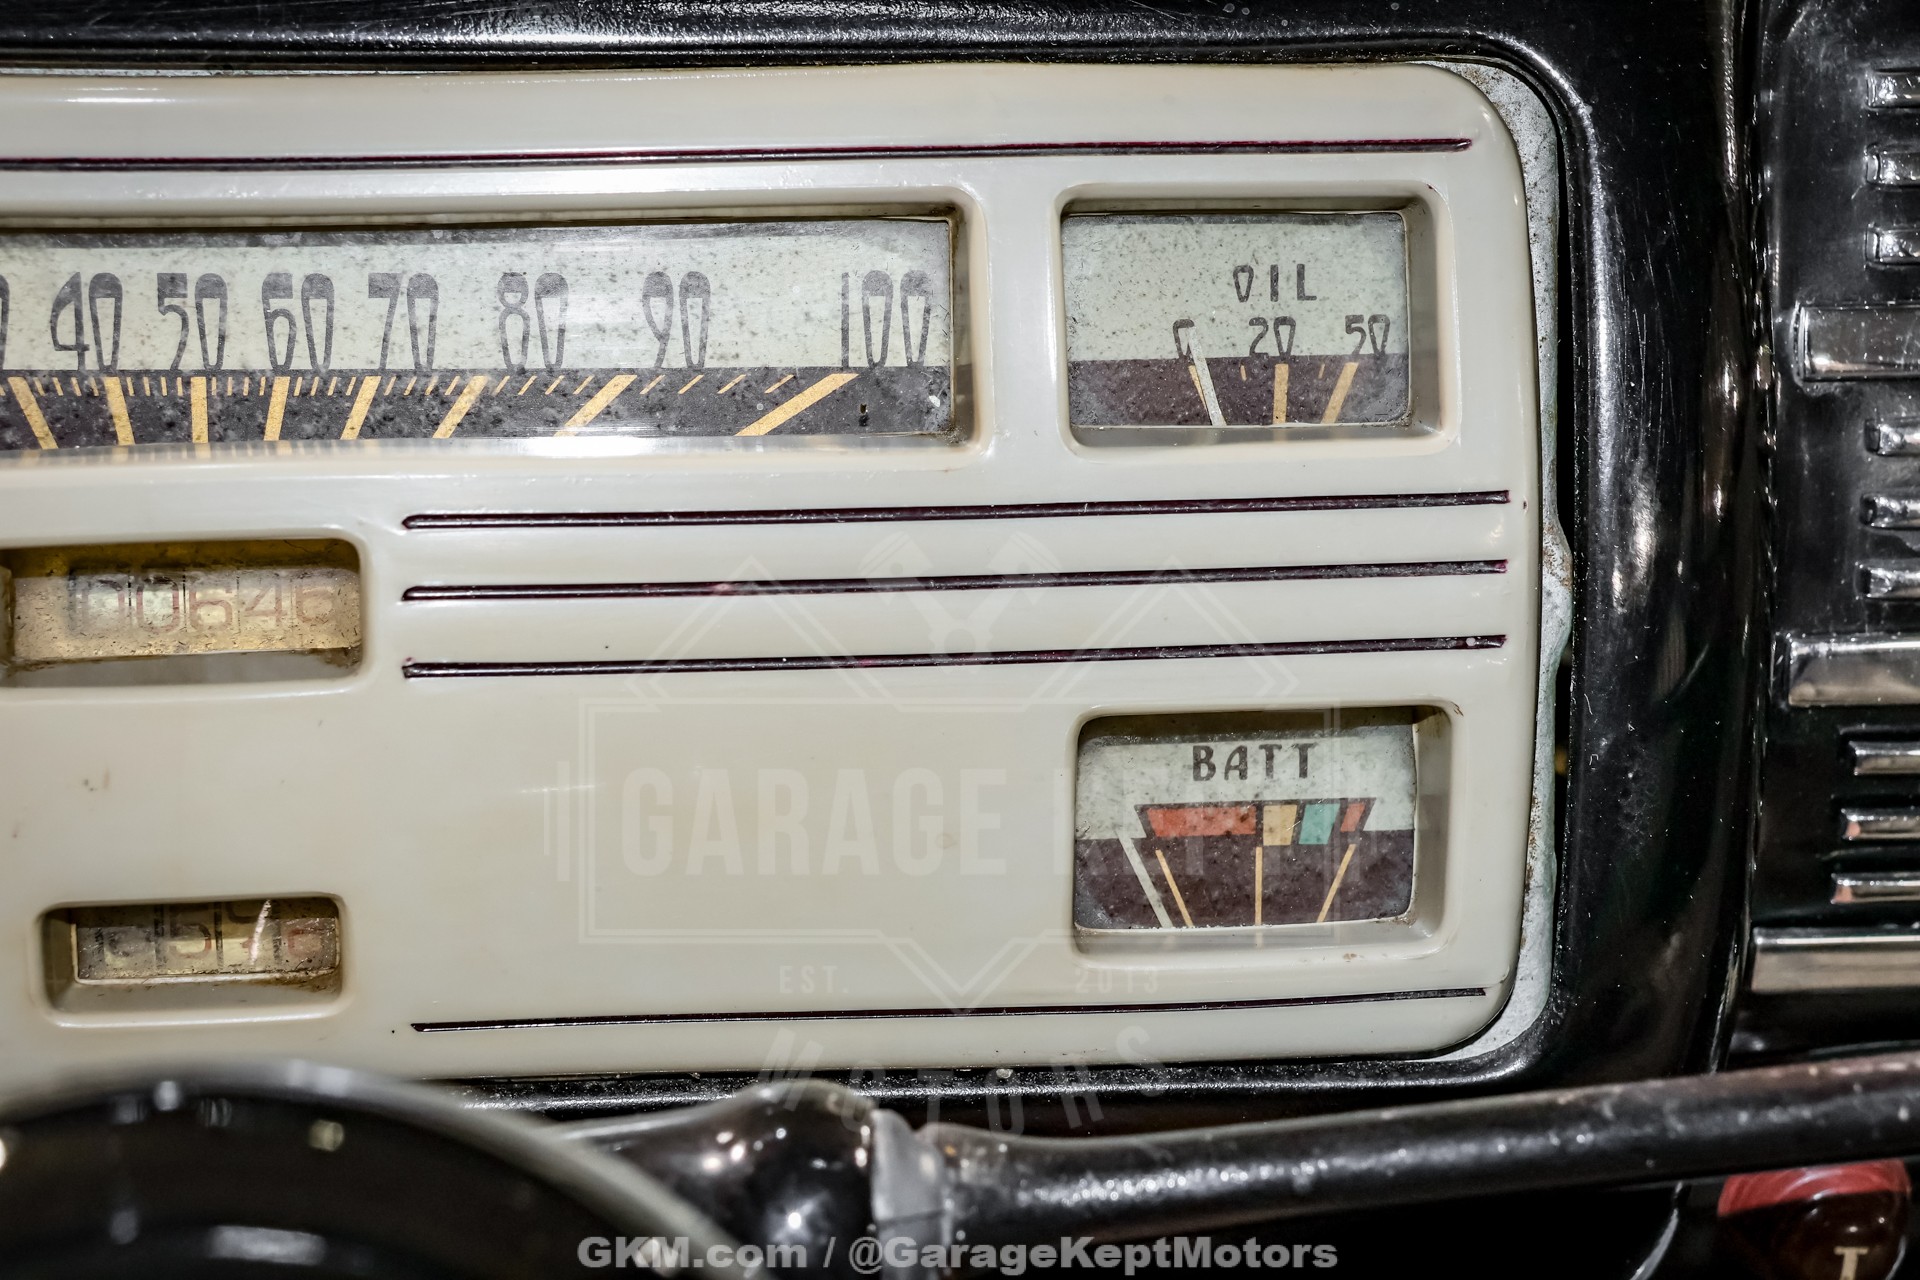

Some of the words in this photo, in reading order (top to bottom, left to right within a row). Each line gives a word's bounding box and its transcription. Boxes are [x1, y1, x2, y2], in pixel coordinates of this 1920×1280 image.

[1232, 263, 1318, 302] OIL
[50, 271, 123, 371] 40
[157, 272, 228, 371] 50
[261, 272, 335, 371] 60
[368, 272, 439, 370] 70
[498, 271, 569, 370] 80
[642, 270, 711, 368] 90
[841, 269, 931, 367] 100
[1248, 315, 1296, 358] 20
[1345, 313, 1390, 356] 50
[1192, 743, 1319, 782] BATT
